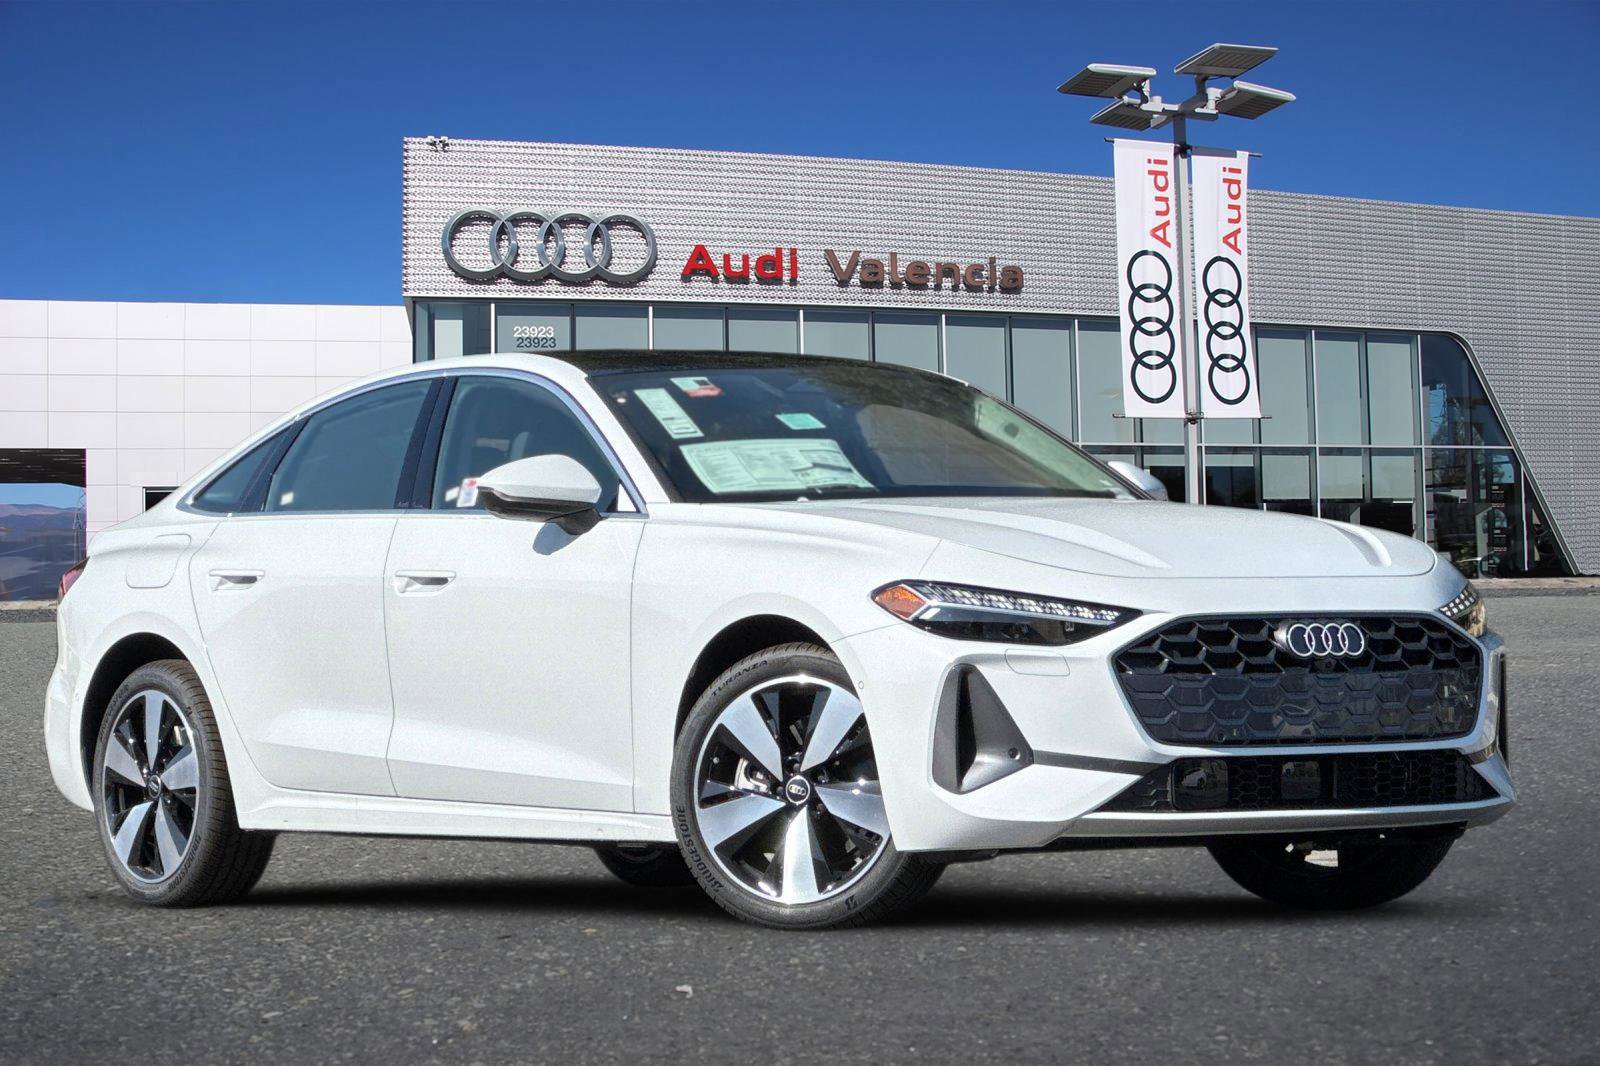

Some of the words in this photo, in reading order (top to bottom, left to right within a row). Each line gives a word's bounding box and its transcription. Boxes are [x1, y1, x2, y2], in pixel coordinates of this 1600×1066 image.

[1147, 158, 1171, 248] Audi
[1222, 166, 1242, 255] Audi
[681, 244, 799, 283] Audi
[823, 249, 1025, 292] Valencia
[513, 326, 554, 338] 23923
[516, 337, 557, 348] 23923
